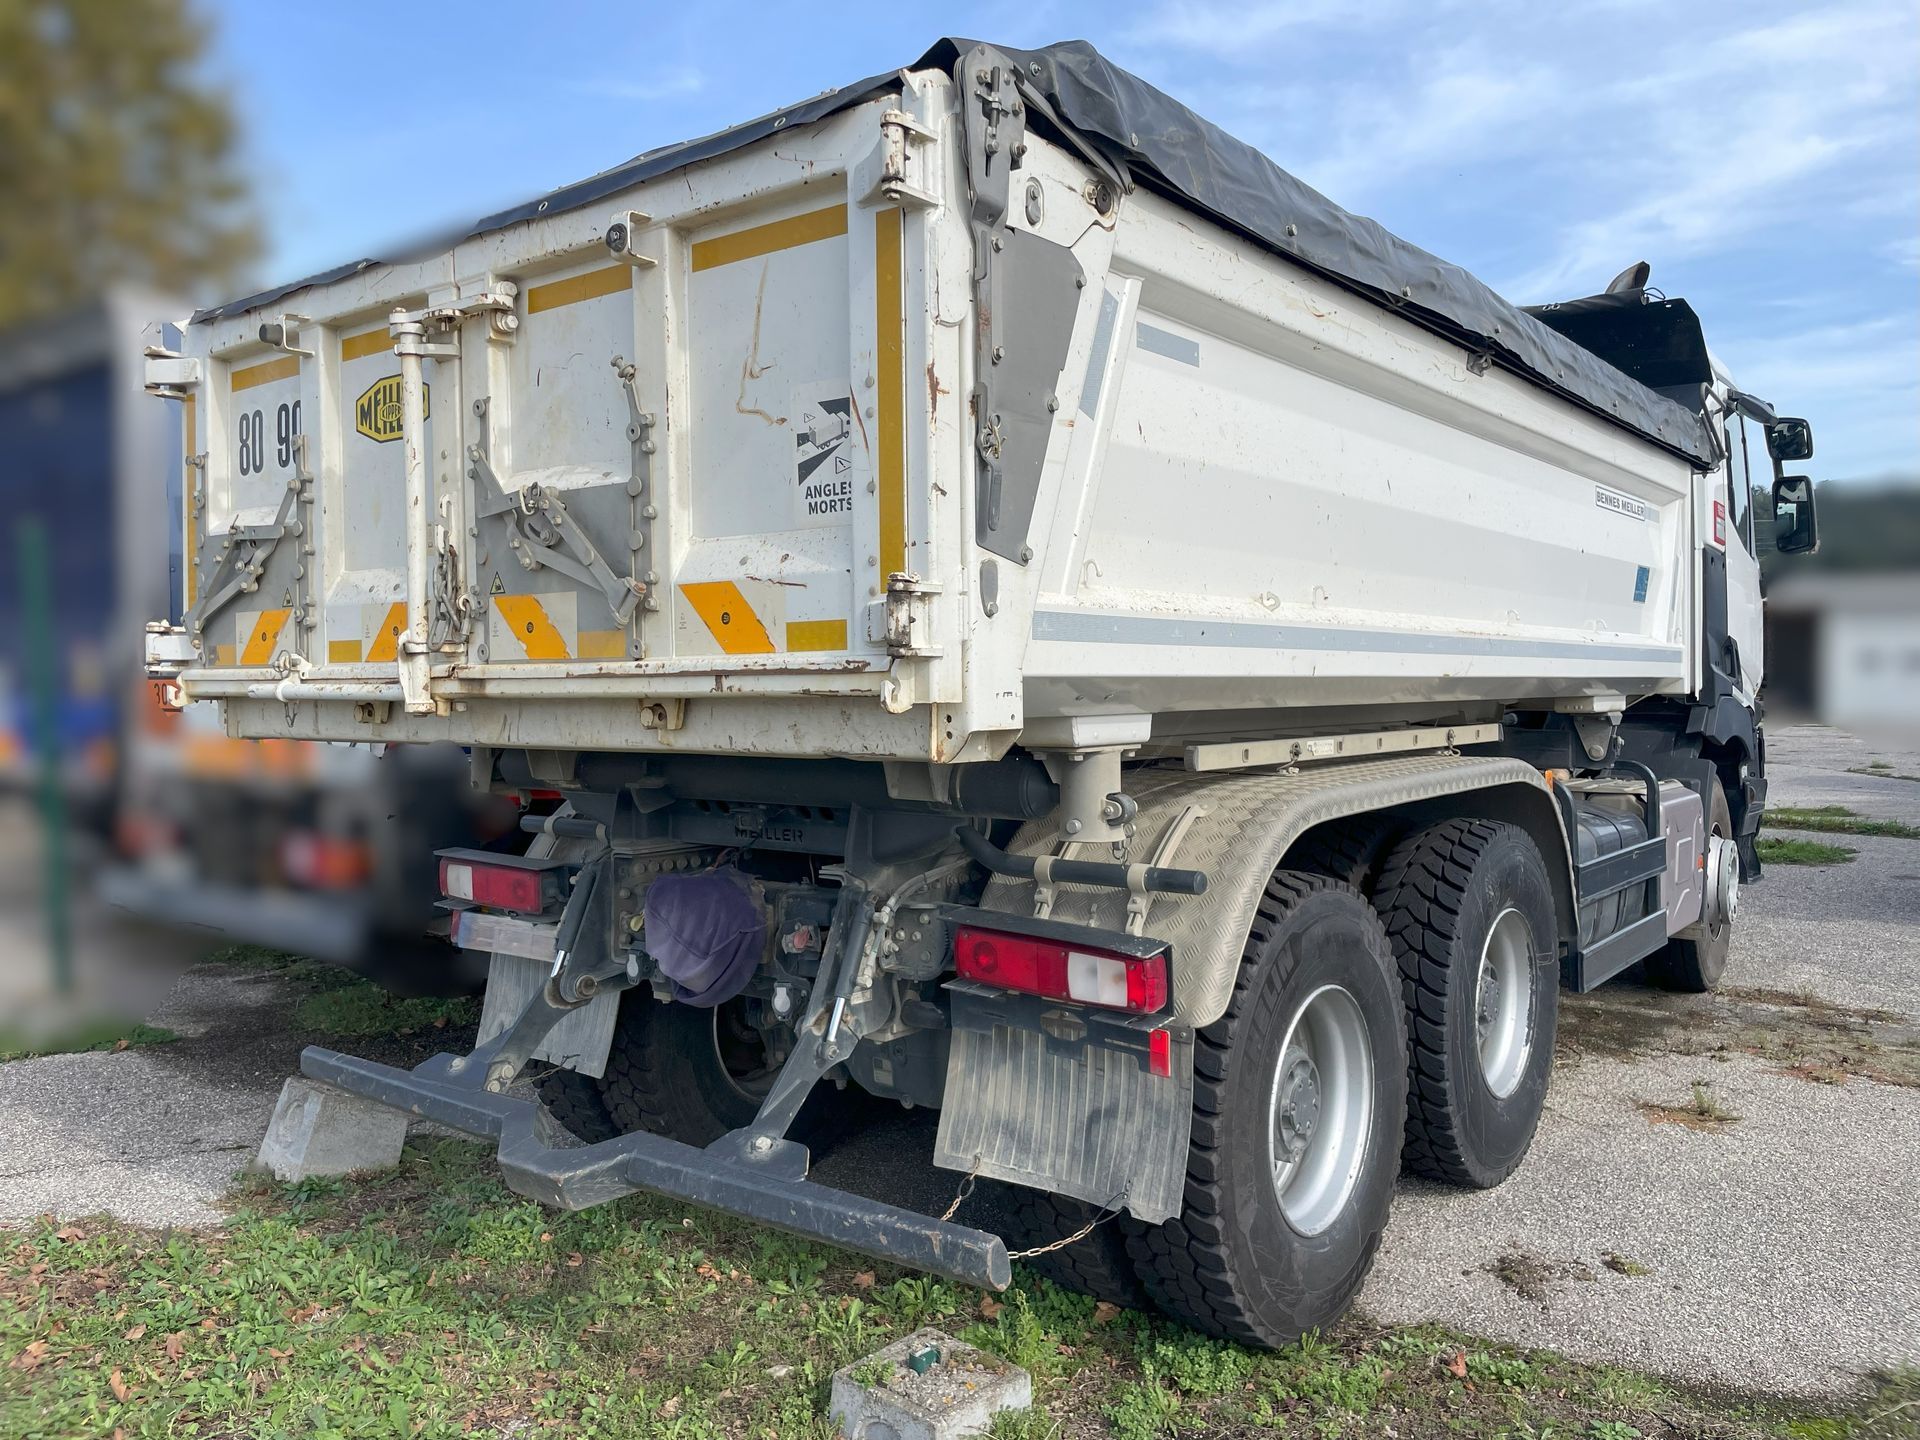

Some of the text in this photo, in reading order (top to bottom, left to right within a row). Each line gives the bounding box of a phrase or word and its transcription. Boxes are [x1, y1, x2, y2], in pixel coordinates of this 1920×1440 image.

[360, 381, 425, 435] MEILL
[239, 409, 263, 477] 80
[808, 497, 852, 515] MORTS
[1596, 490, 1620, 509] BENNES
